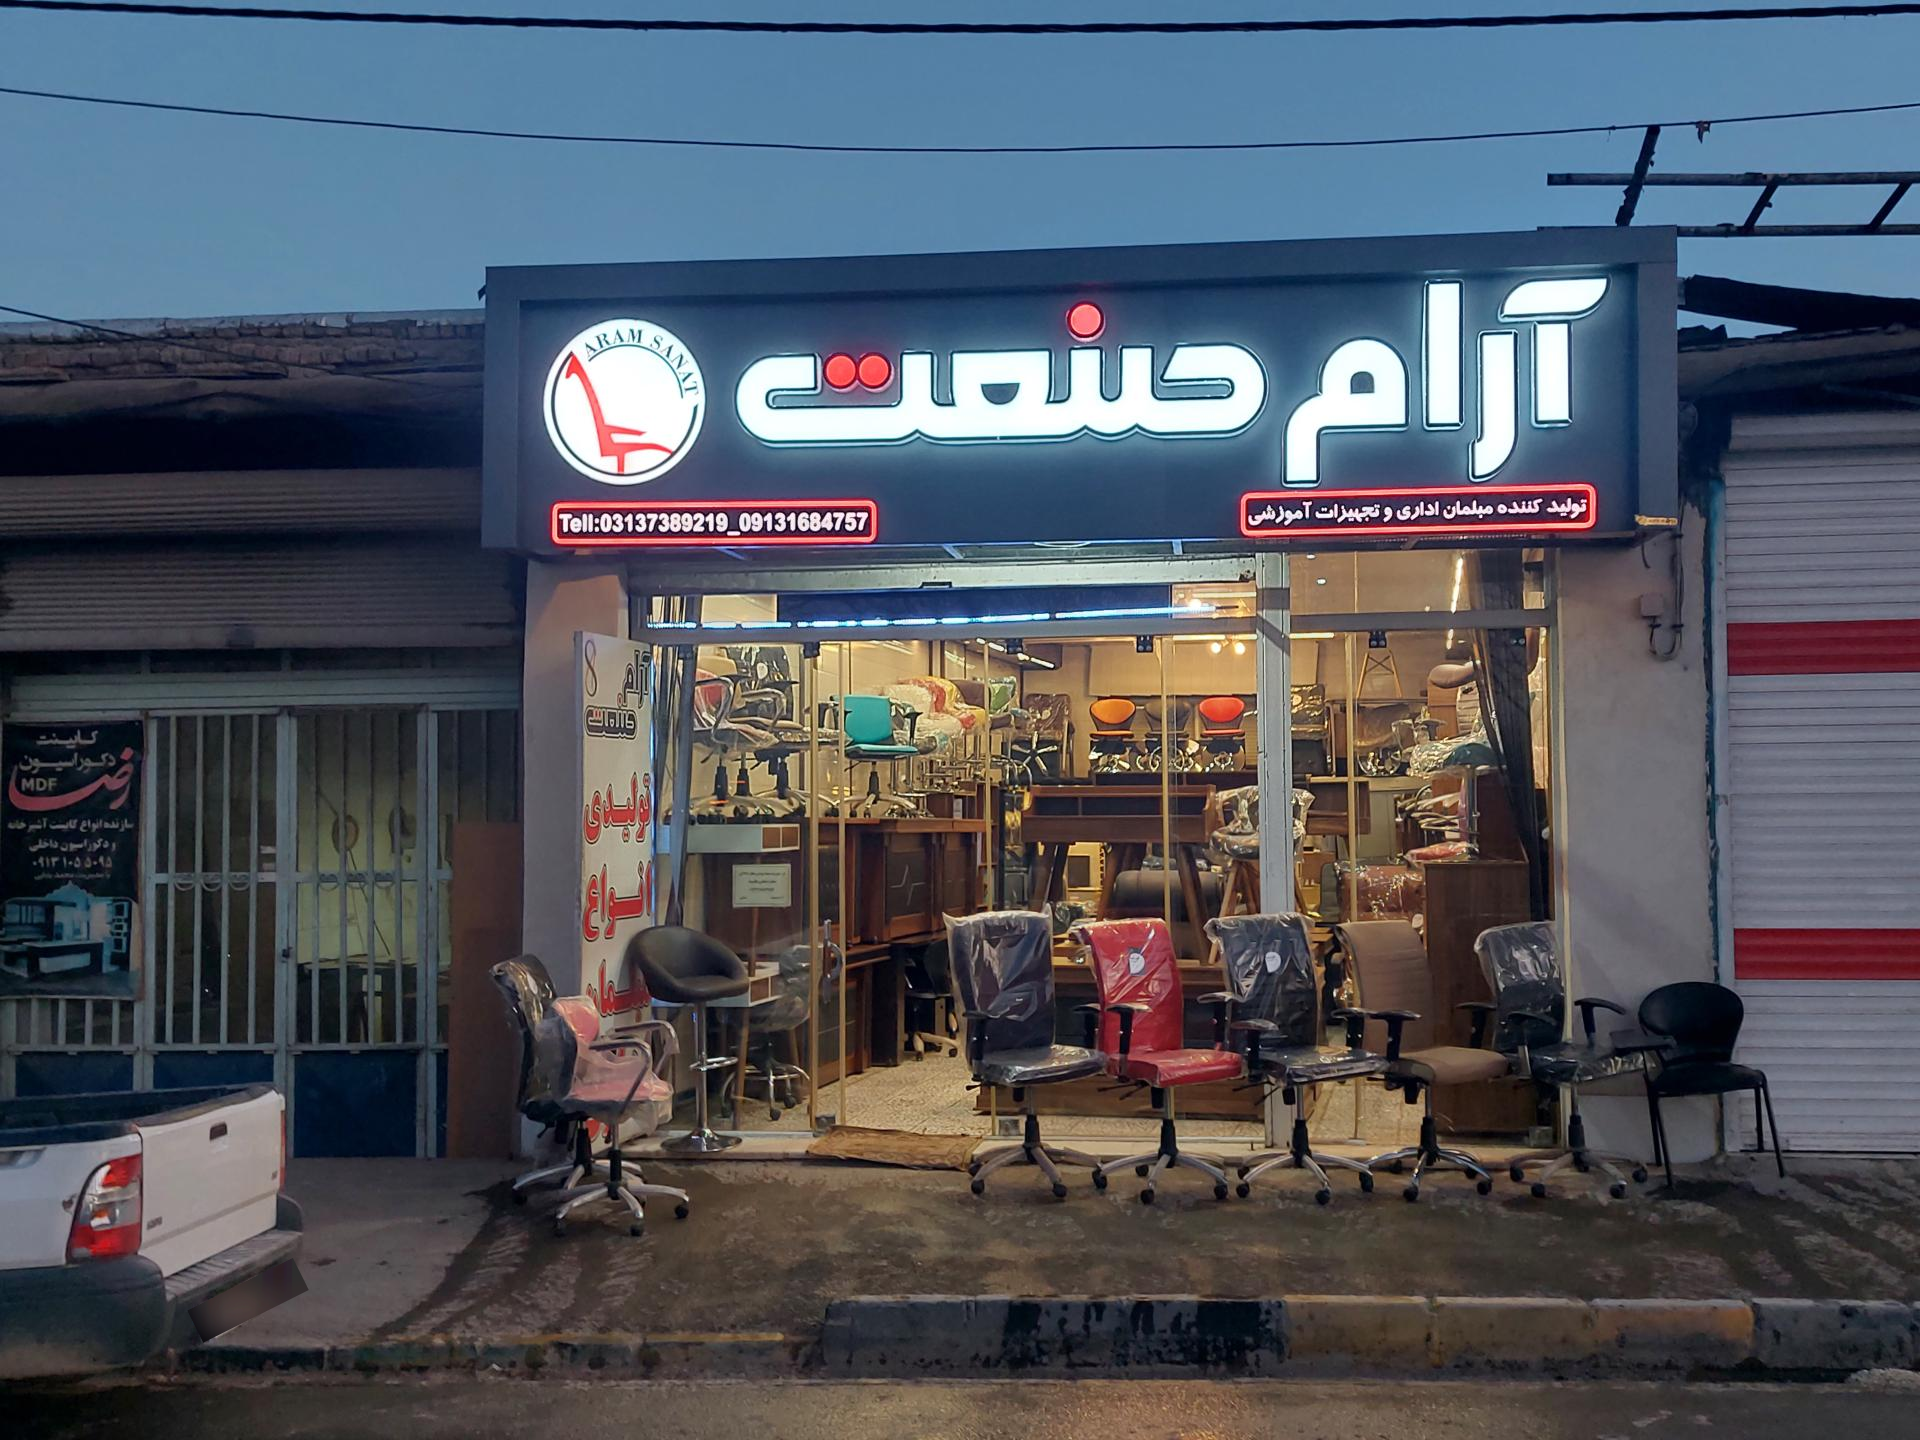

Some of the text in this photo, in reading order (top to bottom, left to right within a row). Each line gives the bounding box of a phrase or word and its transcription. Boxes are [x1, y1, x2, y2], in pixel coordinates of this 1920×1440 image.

[584, 328, 699, 396] ARAM SANAT
[736, 274, 1611, 487] آرام صنعت
[1247, 497, 1587, 526] تولید کننده مبلمان اداری و تجهیزات آموزشی
[622, 649, 651, 709] آرام
[584, 692, 637, 739] صنعت
[36, 728, 99, 749] کابینت
[19, 752, 116, 774] دکوراسیون
[21, 777, 58, 792] MDF
[583, 772, 652, 844] تولیدی
[79, 818, 103, 832] انواع
[28, 838, 59, 852] داخلی
[59, 838, 110, 852] دکوراسیون
[583, 861, 653, 941] انواع
